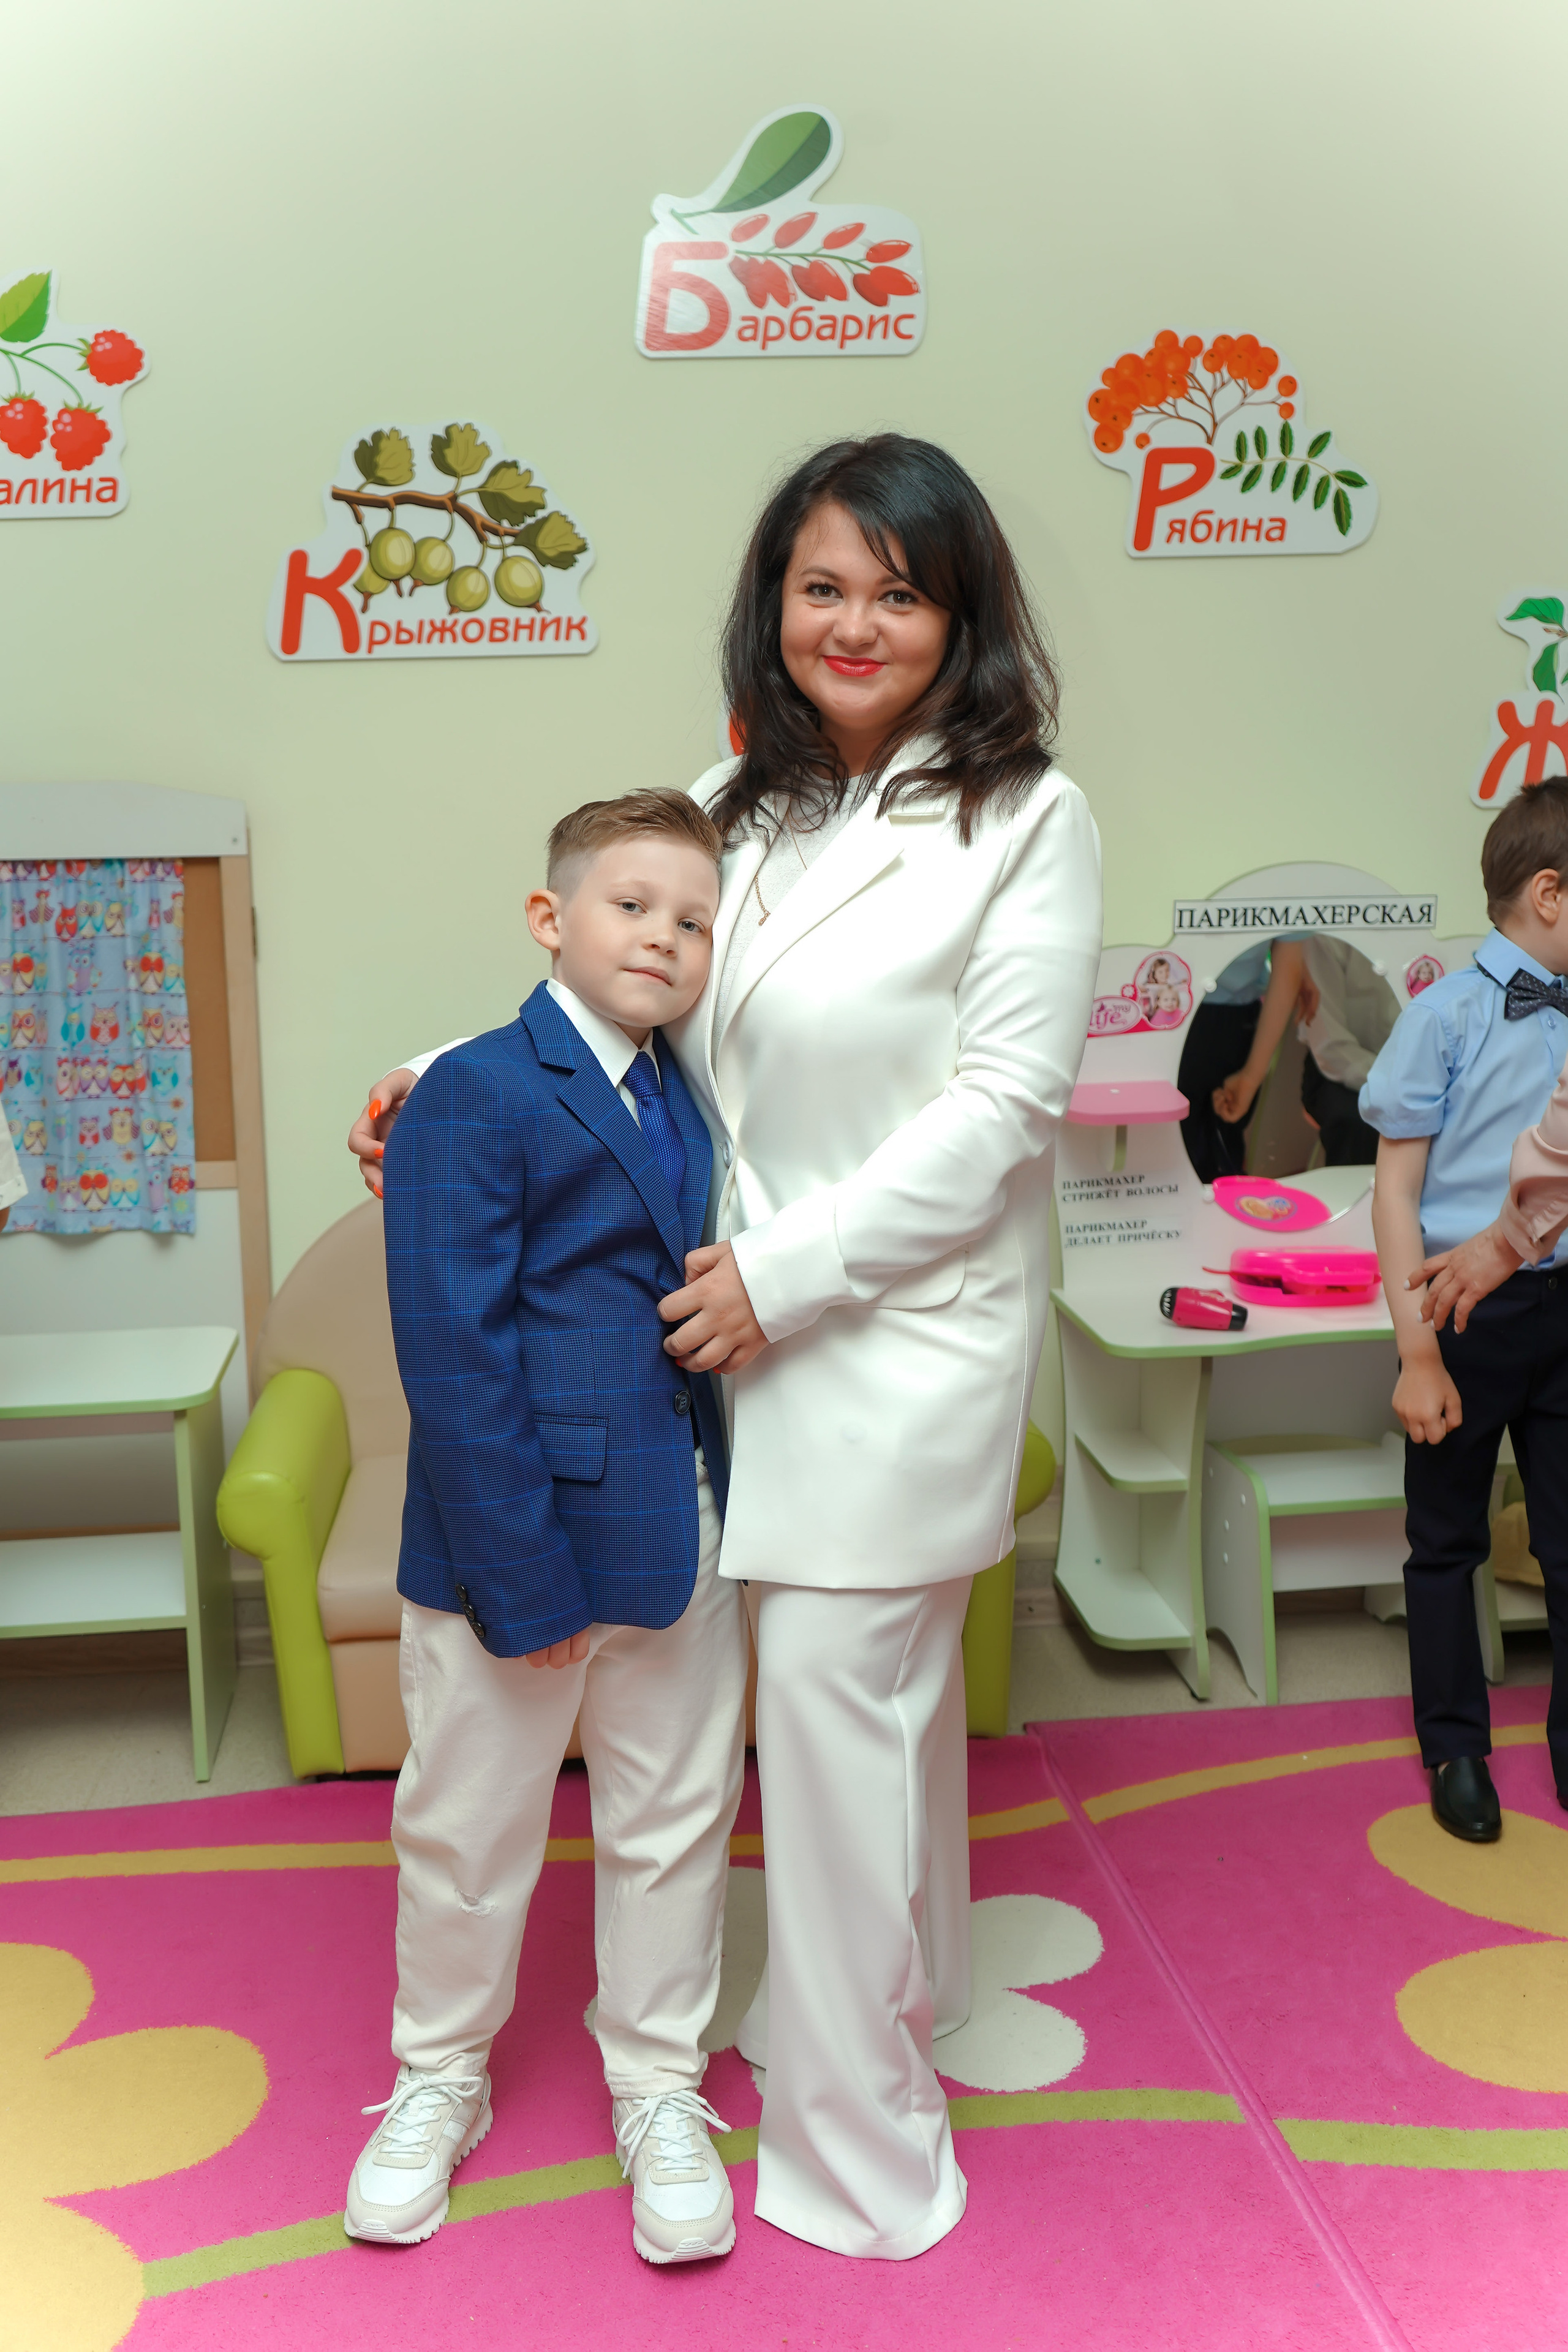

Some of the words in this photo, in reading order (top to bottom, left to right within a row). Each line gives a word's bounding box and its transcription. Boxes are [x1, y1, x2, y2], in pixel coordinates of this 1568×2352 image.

[644, 241, 916, 351] Барбарис
[1134, 447, 1287, 551] Рябина
[280, 548, 588, 655] Крыжовник
[1176, 903, 1435, 929] ПАРИКМАХЕРСКАЯ
[1063, 1174, 1145, 1189] ПАРИКМАХЕР
[1063, 1188, 1120, 1202] СТРИЖЁТ
[1126, 1184, 1179, 1197] ВОЛОСЫ
[1065, 1219, 1147, 1234] ПАРИКМАХЕР
[1065, 1234, 1112, 1248] ДЕЛАЕТ
